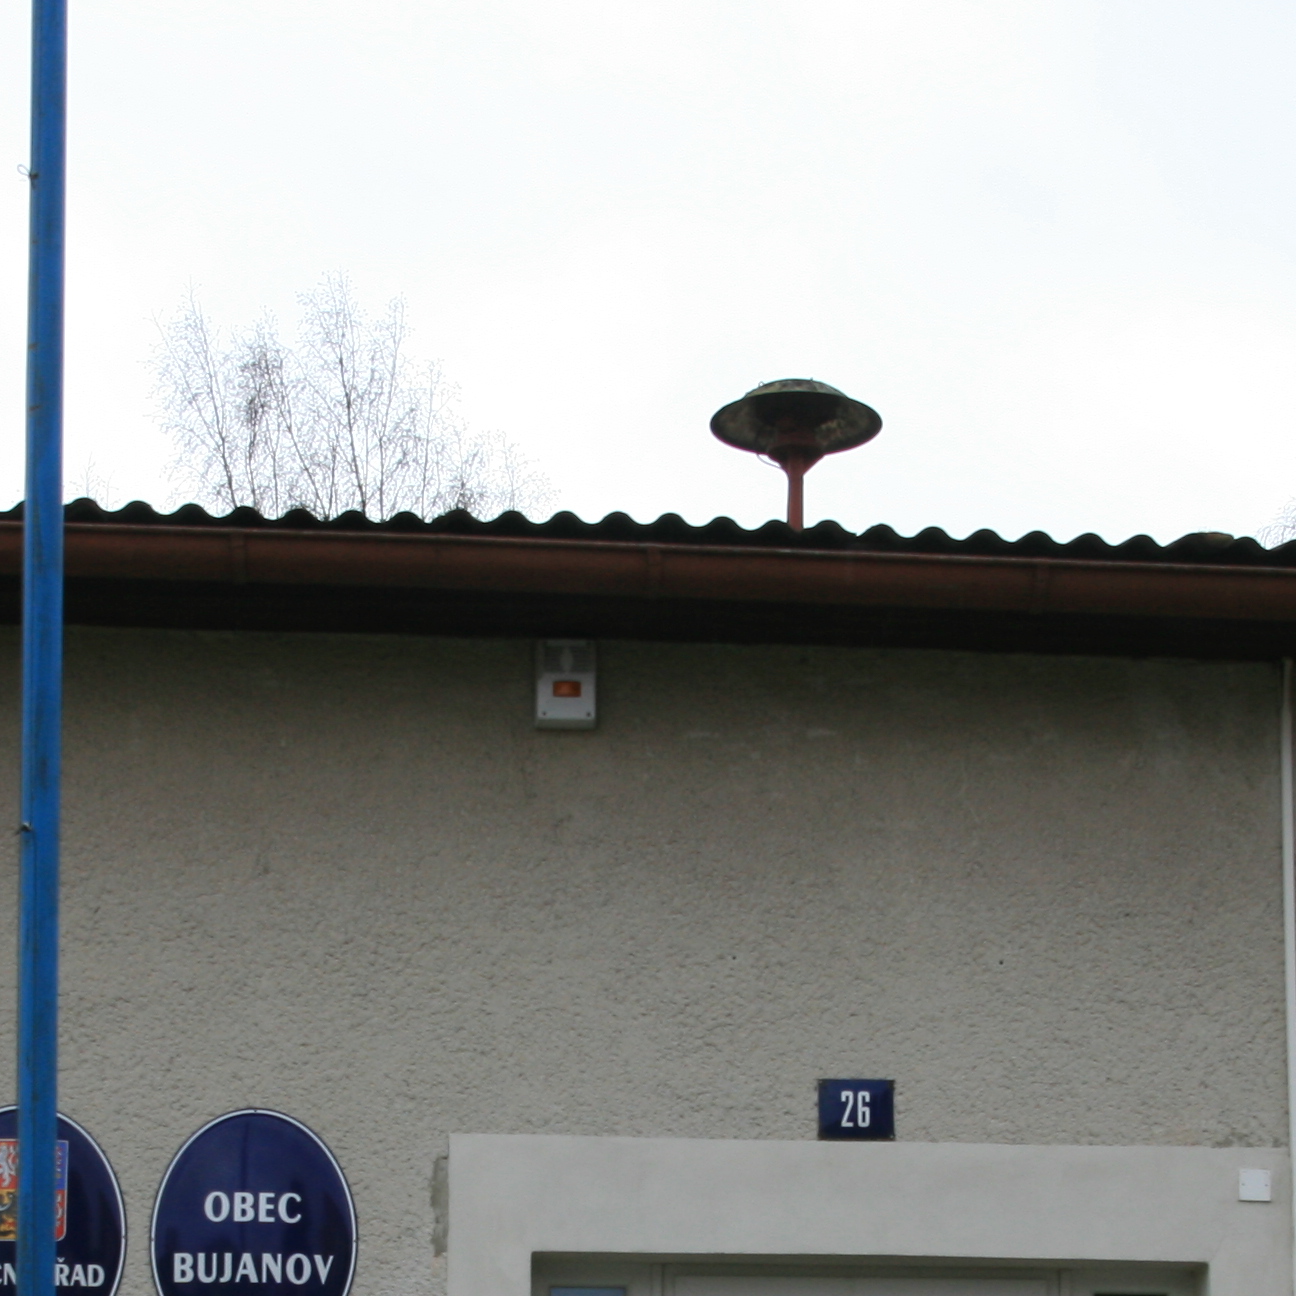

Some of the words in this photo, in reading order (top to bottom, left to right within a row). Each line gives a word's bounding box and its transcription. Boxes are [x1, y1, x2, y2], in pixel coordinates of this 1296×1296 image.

[840, 1090, 871, 1128] 26
[203, 1190, 303, 1225] OBEC
[55, 1256, 106, 1288] ŘAD
[172, 1251, 335, 1286] BUJANOV
